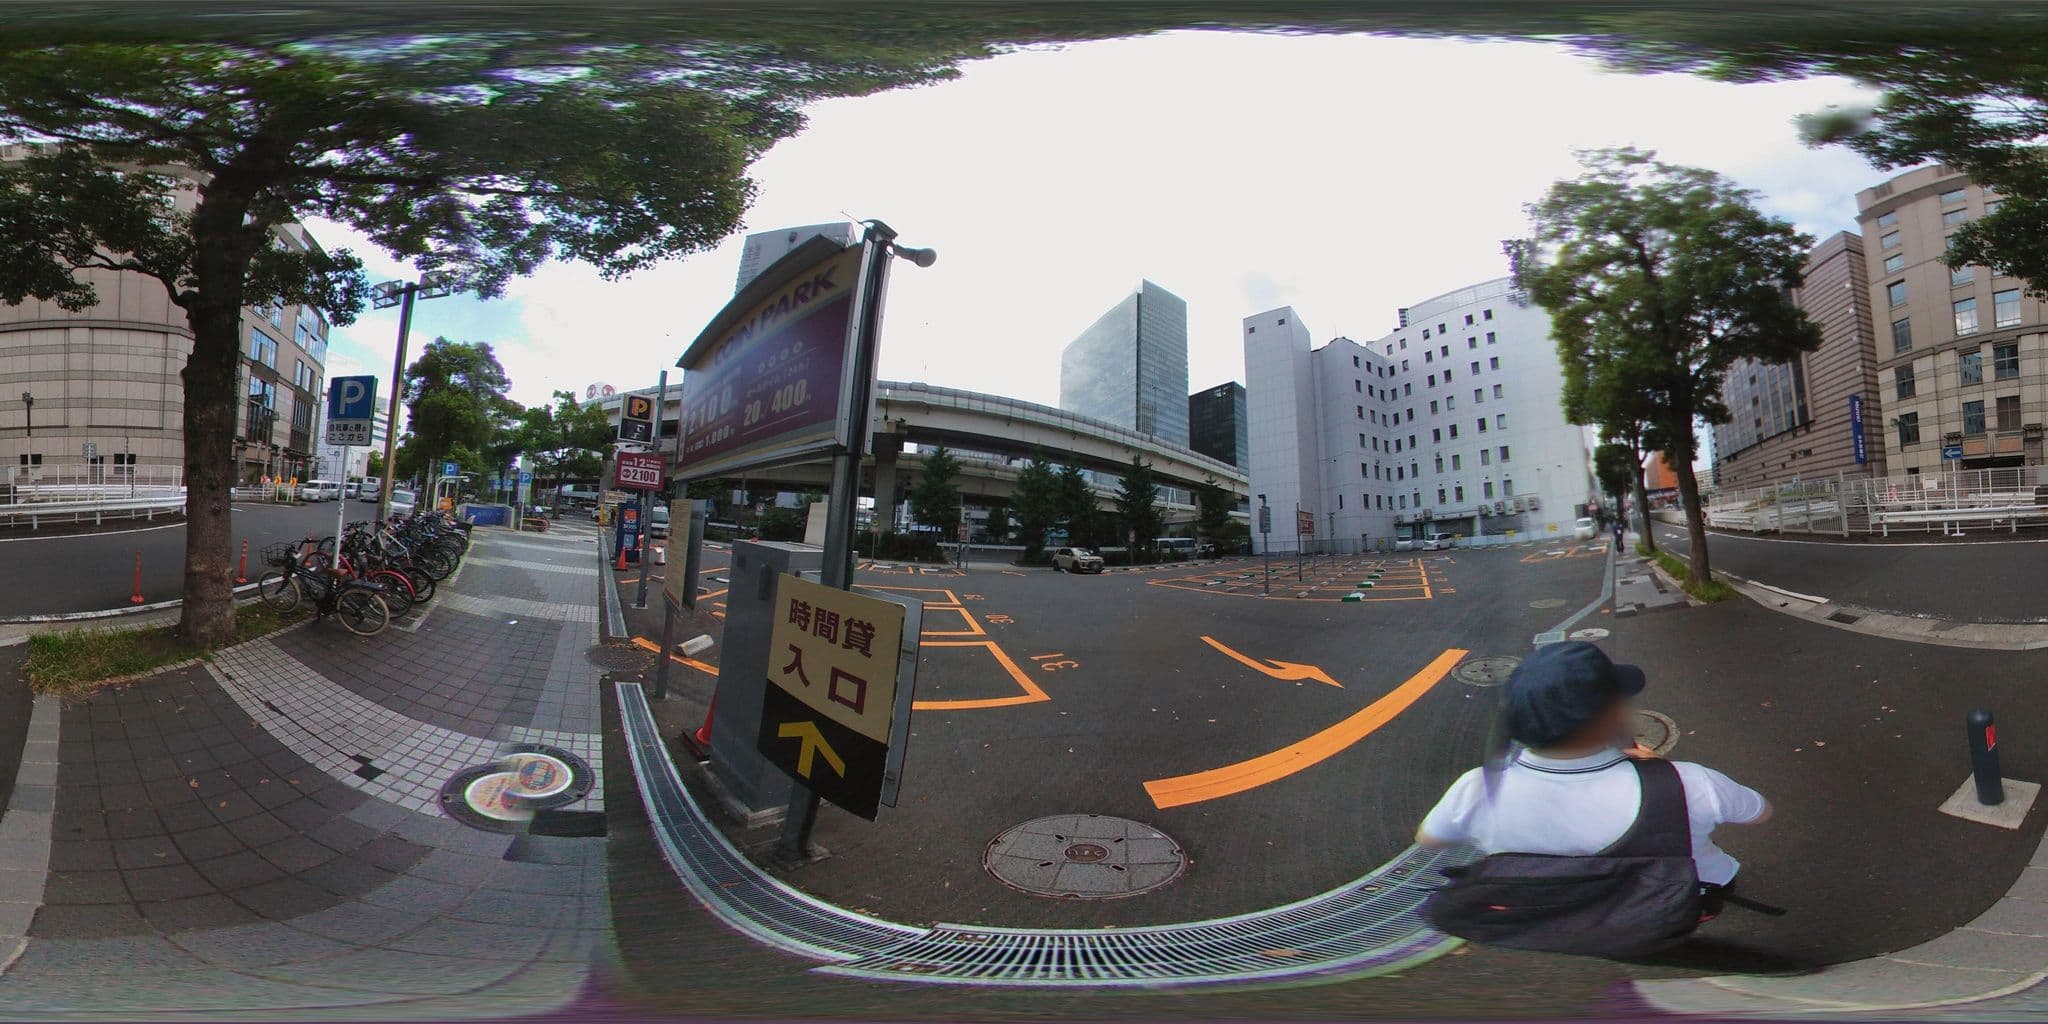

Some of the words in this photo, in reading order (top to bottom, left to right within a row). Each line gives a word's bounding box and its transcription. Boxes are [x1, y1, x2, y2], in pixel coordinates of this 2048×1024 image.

[760, 263, 840, 331] PARK
[339, 380, 366, 415] P
[631, 398, 648, 417] P
[446, 464, 454, 475] P
[522, 473, 530, 482] P
[788, 597, 876, 659] 時間貸
[1030, 652, 1079, 671] 31
[782, 643, 868, 715] 入口
